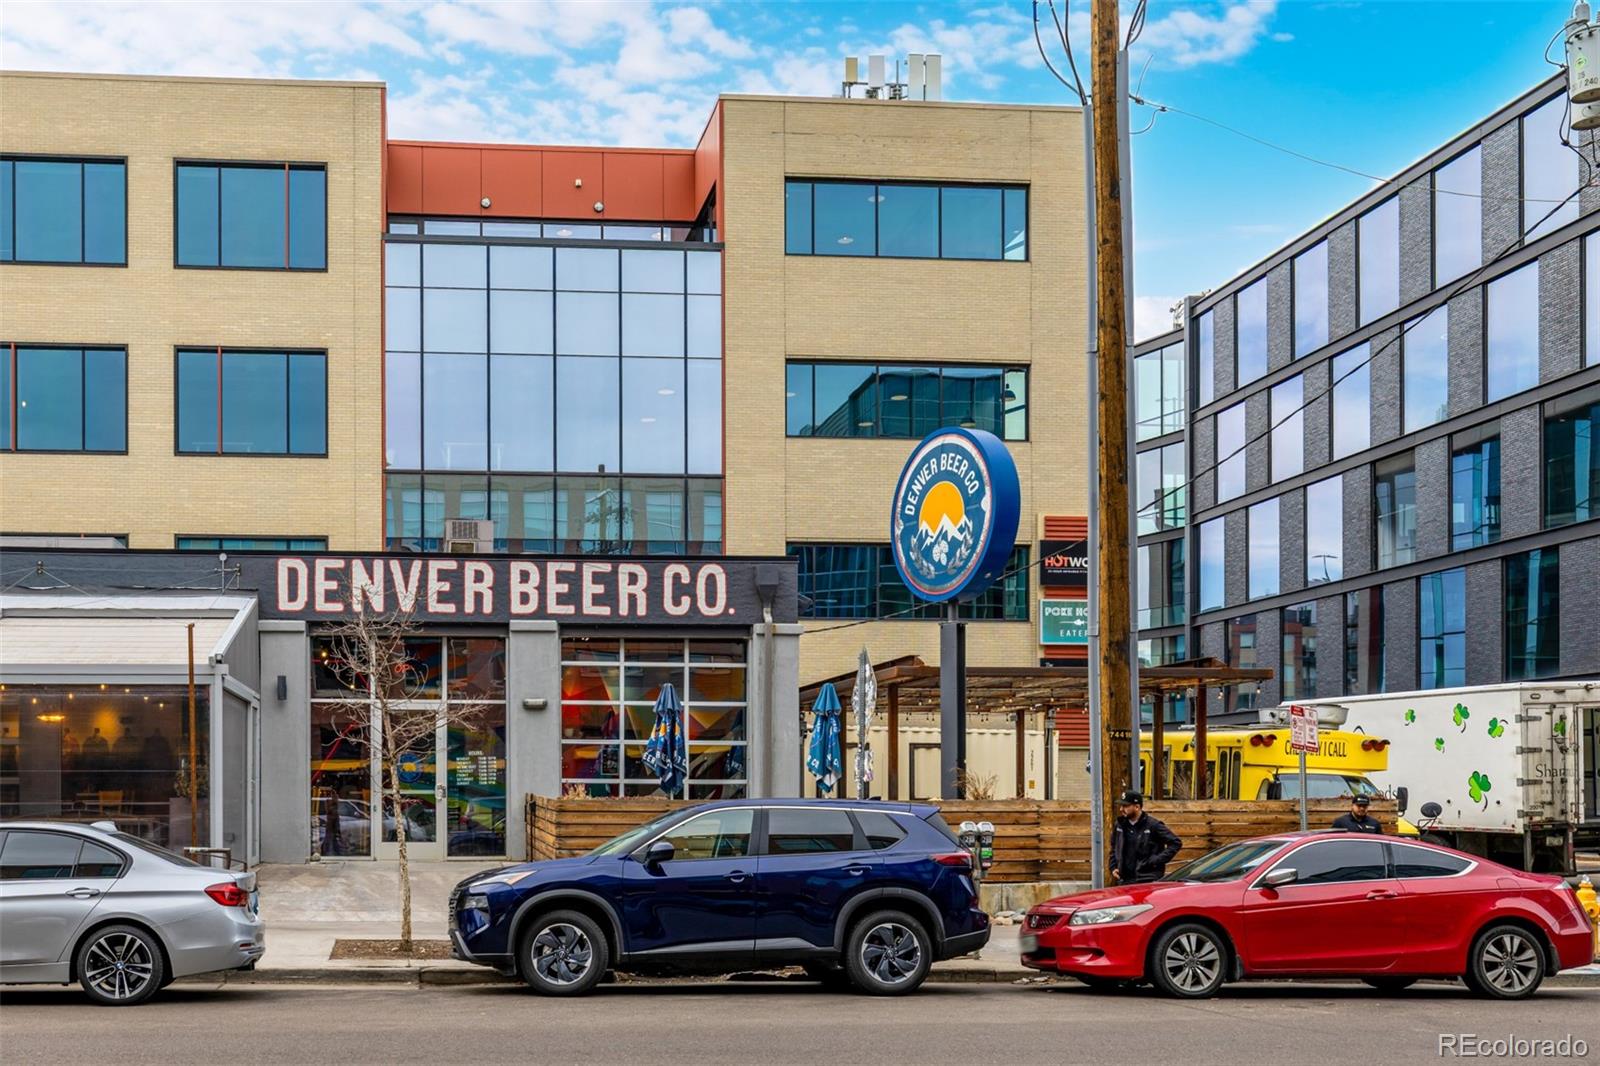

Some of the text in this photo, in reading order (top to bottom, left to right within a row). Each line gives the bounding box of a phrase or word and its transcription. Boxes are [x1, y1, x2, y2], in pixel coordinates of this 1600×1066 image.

[905, 458, 938, 515] DENVER
[940, 453, 968, 478] BEER
[277, 557, 737, 616] DENVER BEER CO.
[1044, 606, 1073, 617] POKE
[1328, 741, 1347, 757] CALL
